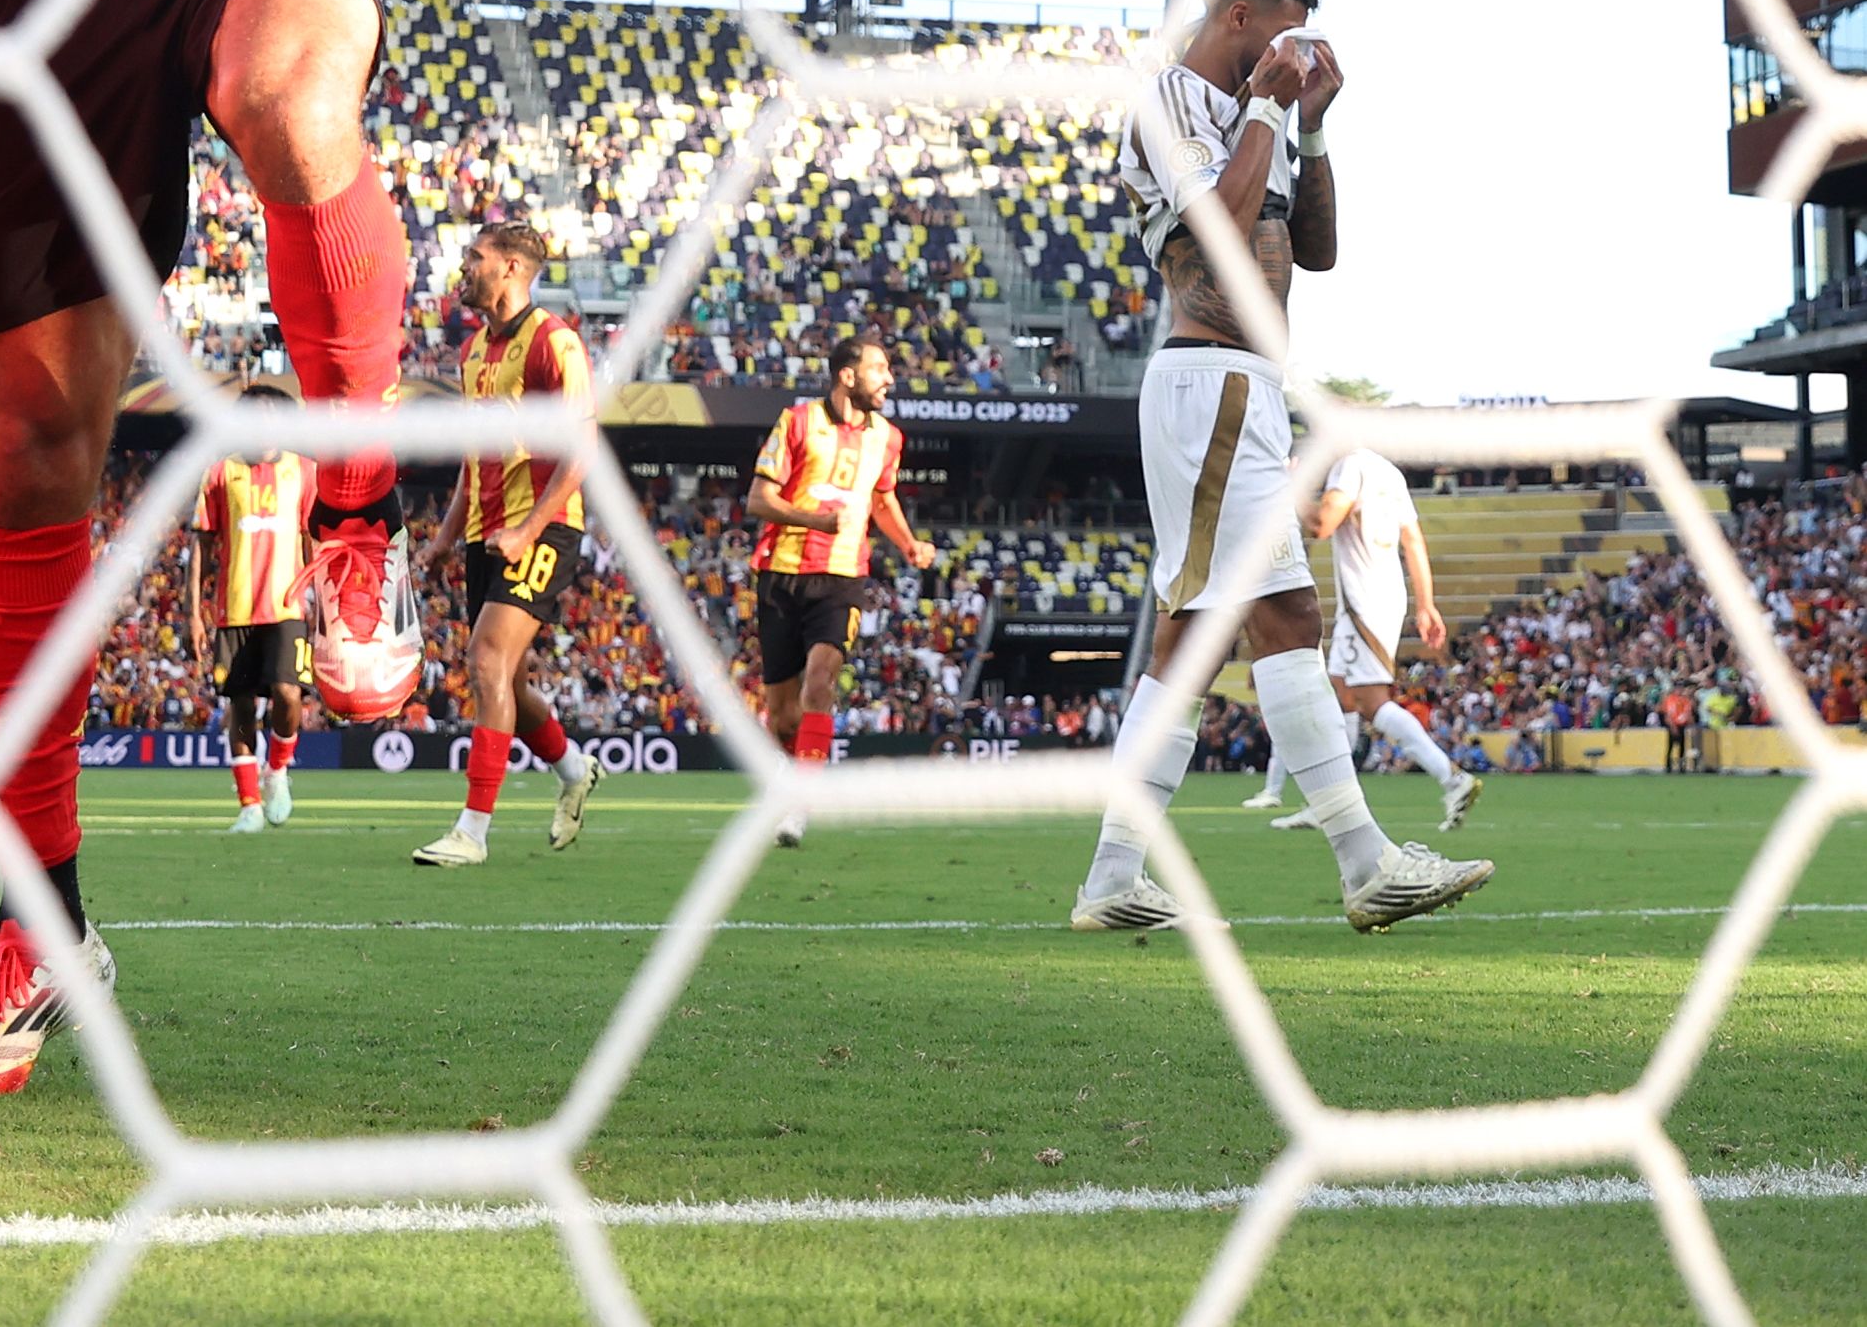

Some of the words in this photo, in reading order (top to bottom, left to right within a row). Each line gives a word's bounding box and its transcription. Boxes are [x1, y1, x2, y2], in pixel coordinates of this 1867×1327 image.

[898, 399, 973, 421] WORLD
[975, 401, 1017, 422] CUP
[1019, 403, 1071, 423] 2025
[831, 447, 860, 488] 6
[251, 485, 276, 515] 14
[449, 731, 678, 773] orola
